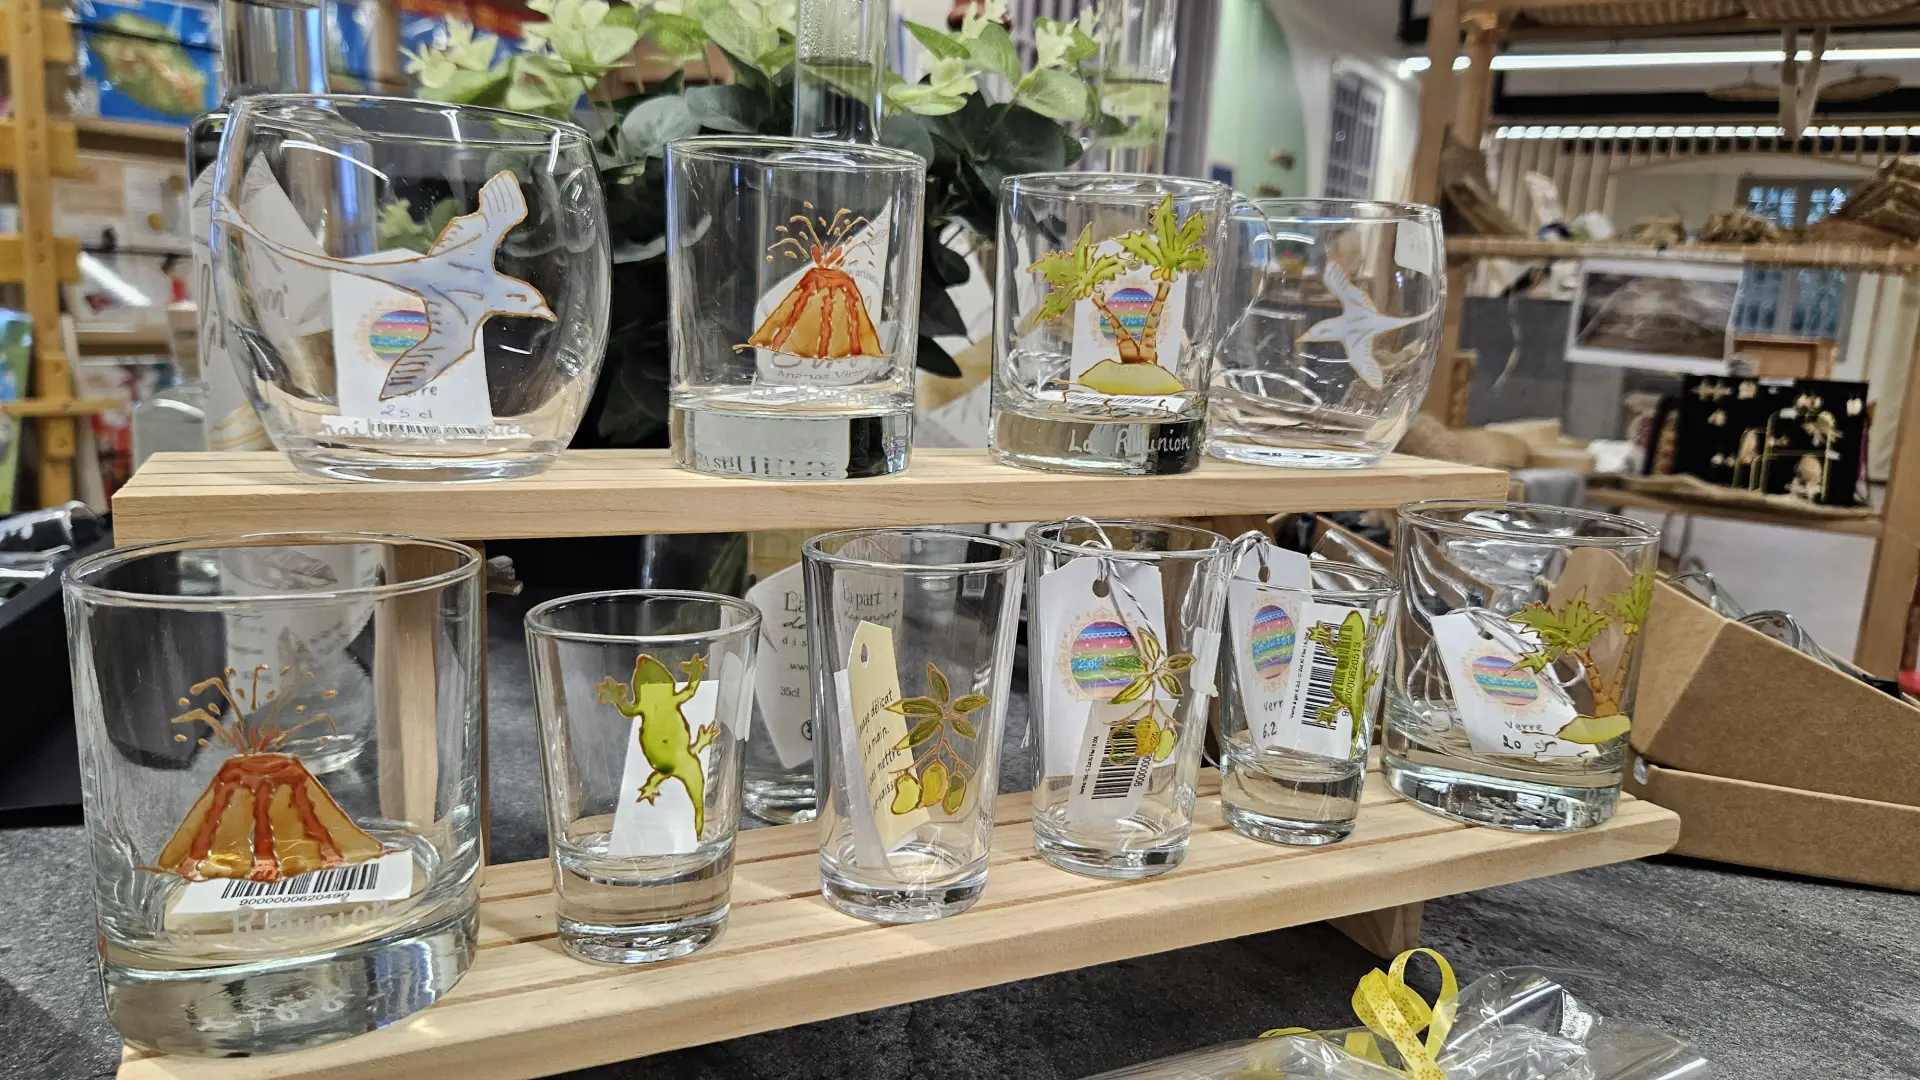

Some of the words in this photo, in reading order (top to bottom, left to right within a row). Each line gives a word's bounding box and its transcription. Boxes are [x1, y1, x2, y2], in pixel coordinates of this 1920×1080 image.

[777, 369, 829, 380] Ananas
[1068, 429, 1093, 453] La
[856, 588, 882, 610] part
[780, 686, 800, 698] 35cl
[871, 687, 893, 717] délicat
[1263, 700, 1284, 712] Verr
[1504, 719, 1544, 732] Verre
[238, 892, 351, 906] 9000000620490
